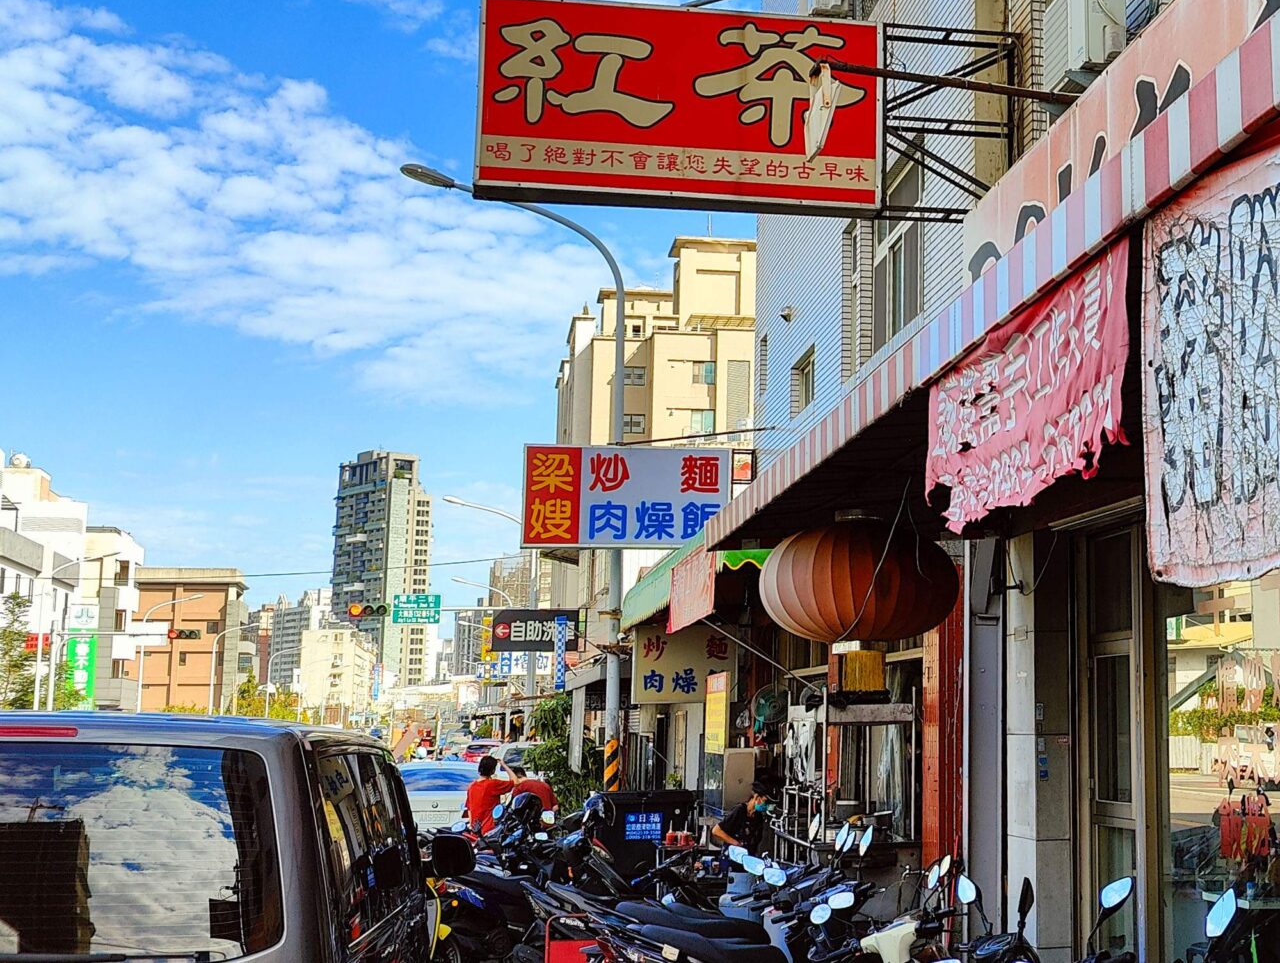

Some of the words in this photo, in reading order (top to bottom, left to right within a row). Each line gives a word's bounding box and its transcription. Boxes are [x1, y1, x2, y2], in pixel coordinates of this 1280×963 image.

[492, 16, 867, 148] 紅茶
[485, 143, 870, 183] 喝了絕對不會讓您失望的古早味
[588, 452, 721, 494] 炒麵
[528, 452, 574, 540] 梁嫂
[588, 500, 721, 540] 肉燥飯
[643, 635, 729, 662] 炒麵
[643, 668, 726, 694] 肉燥
